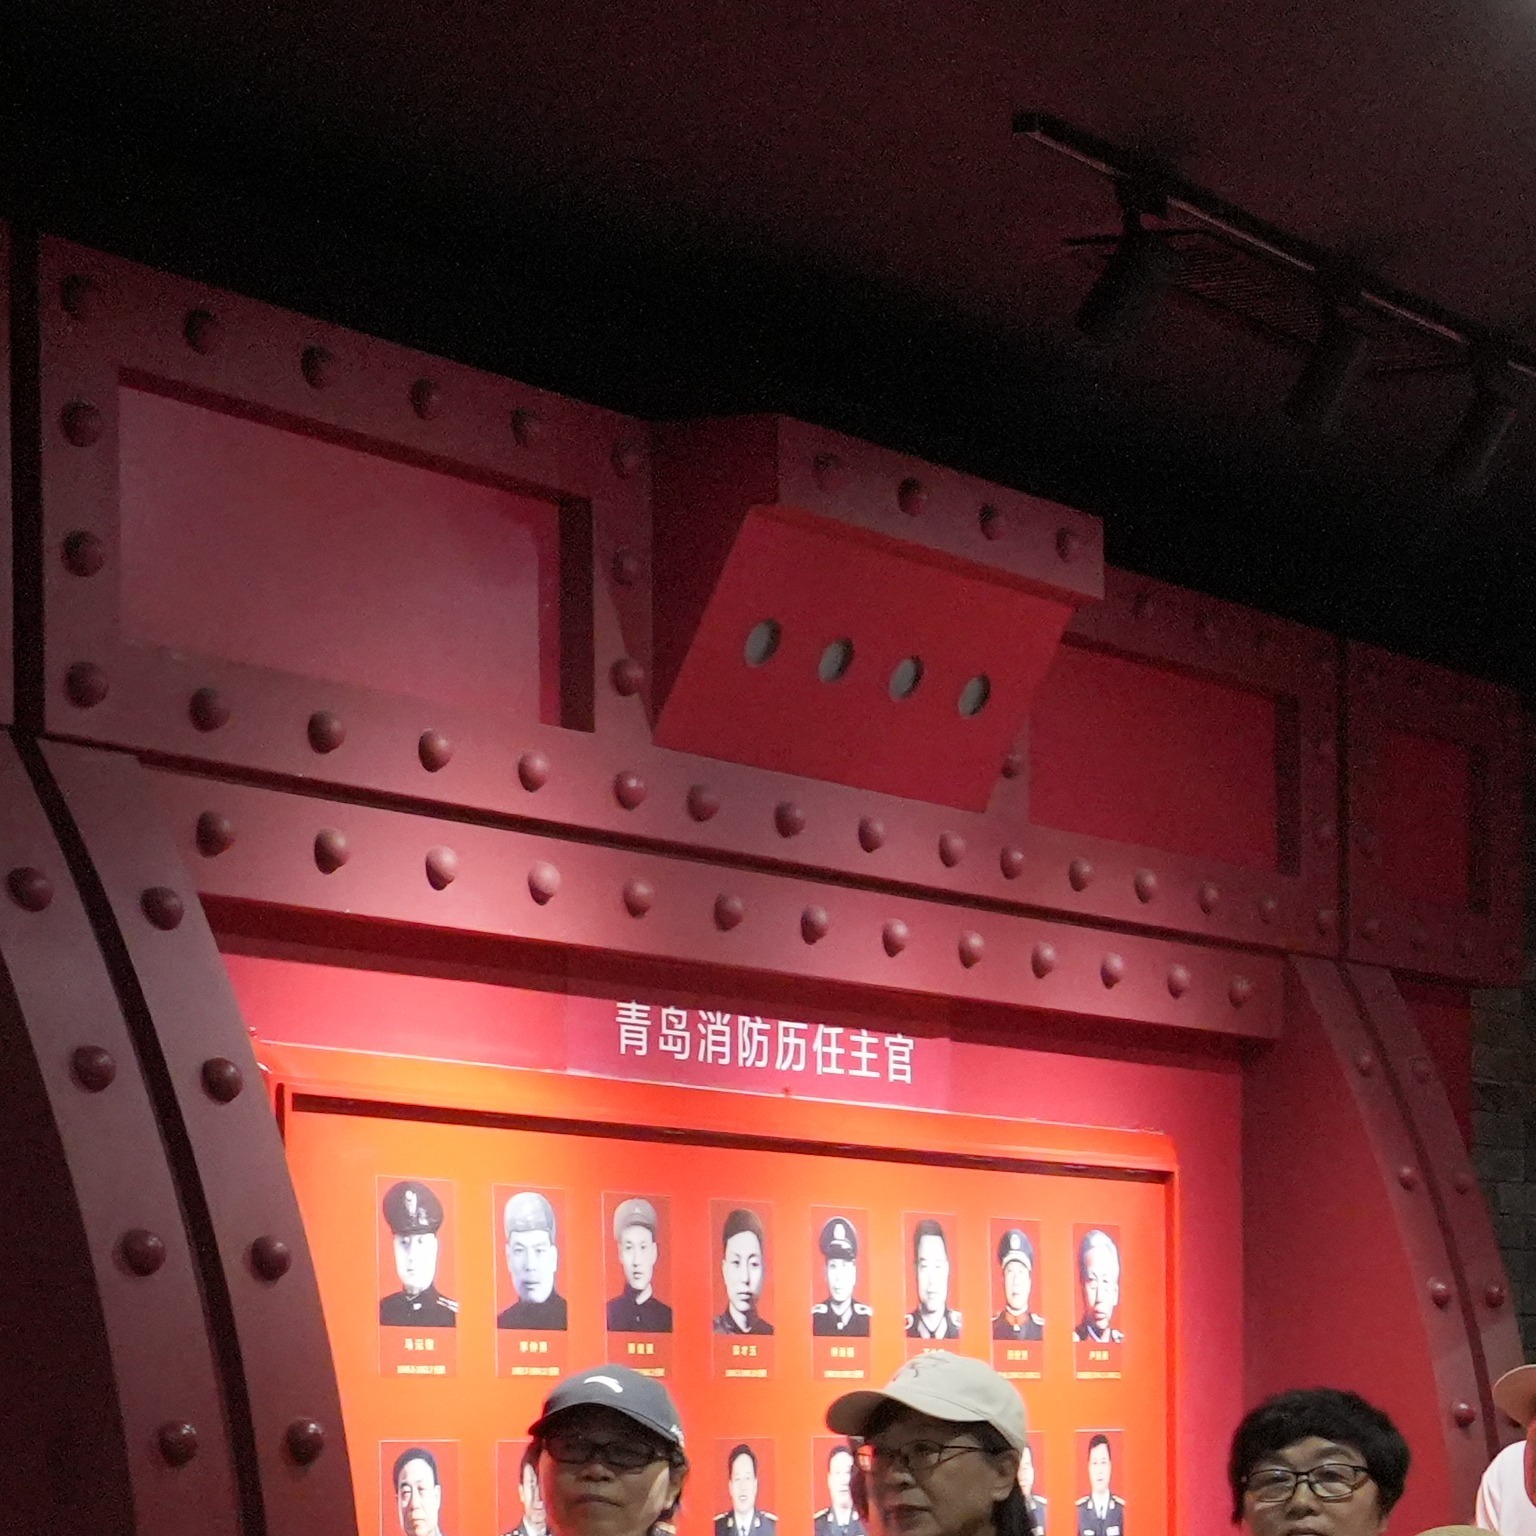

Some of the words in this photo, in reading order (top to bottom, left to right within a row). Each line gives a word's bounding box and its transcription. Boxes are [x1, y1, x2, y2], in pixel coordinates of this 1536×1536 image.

[615, 1000, 915, 1085] 青岛消防历任主官
